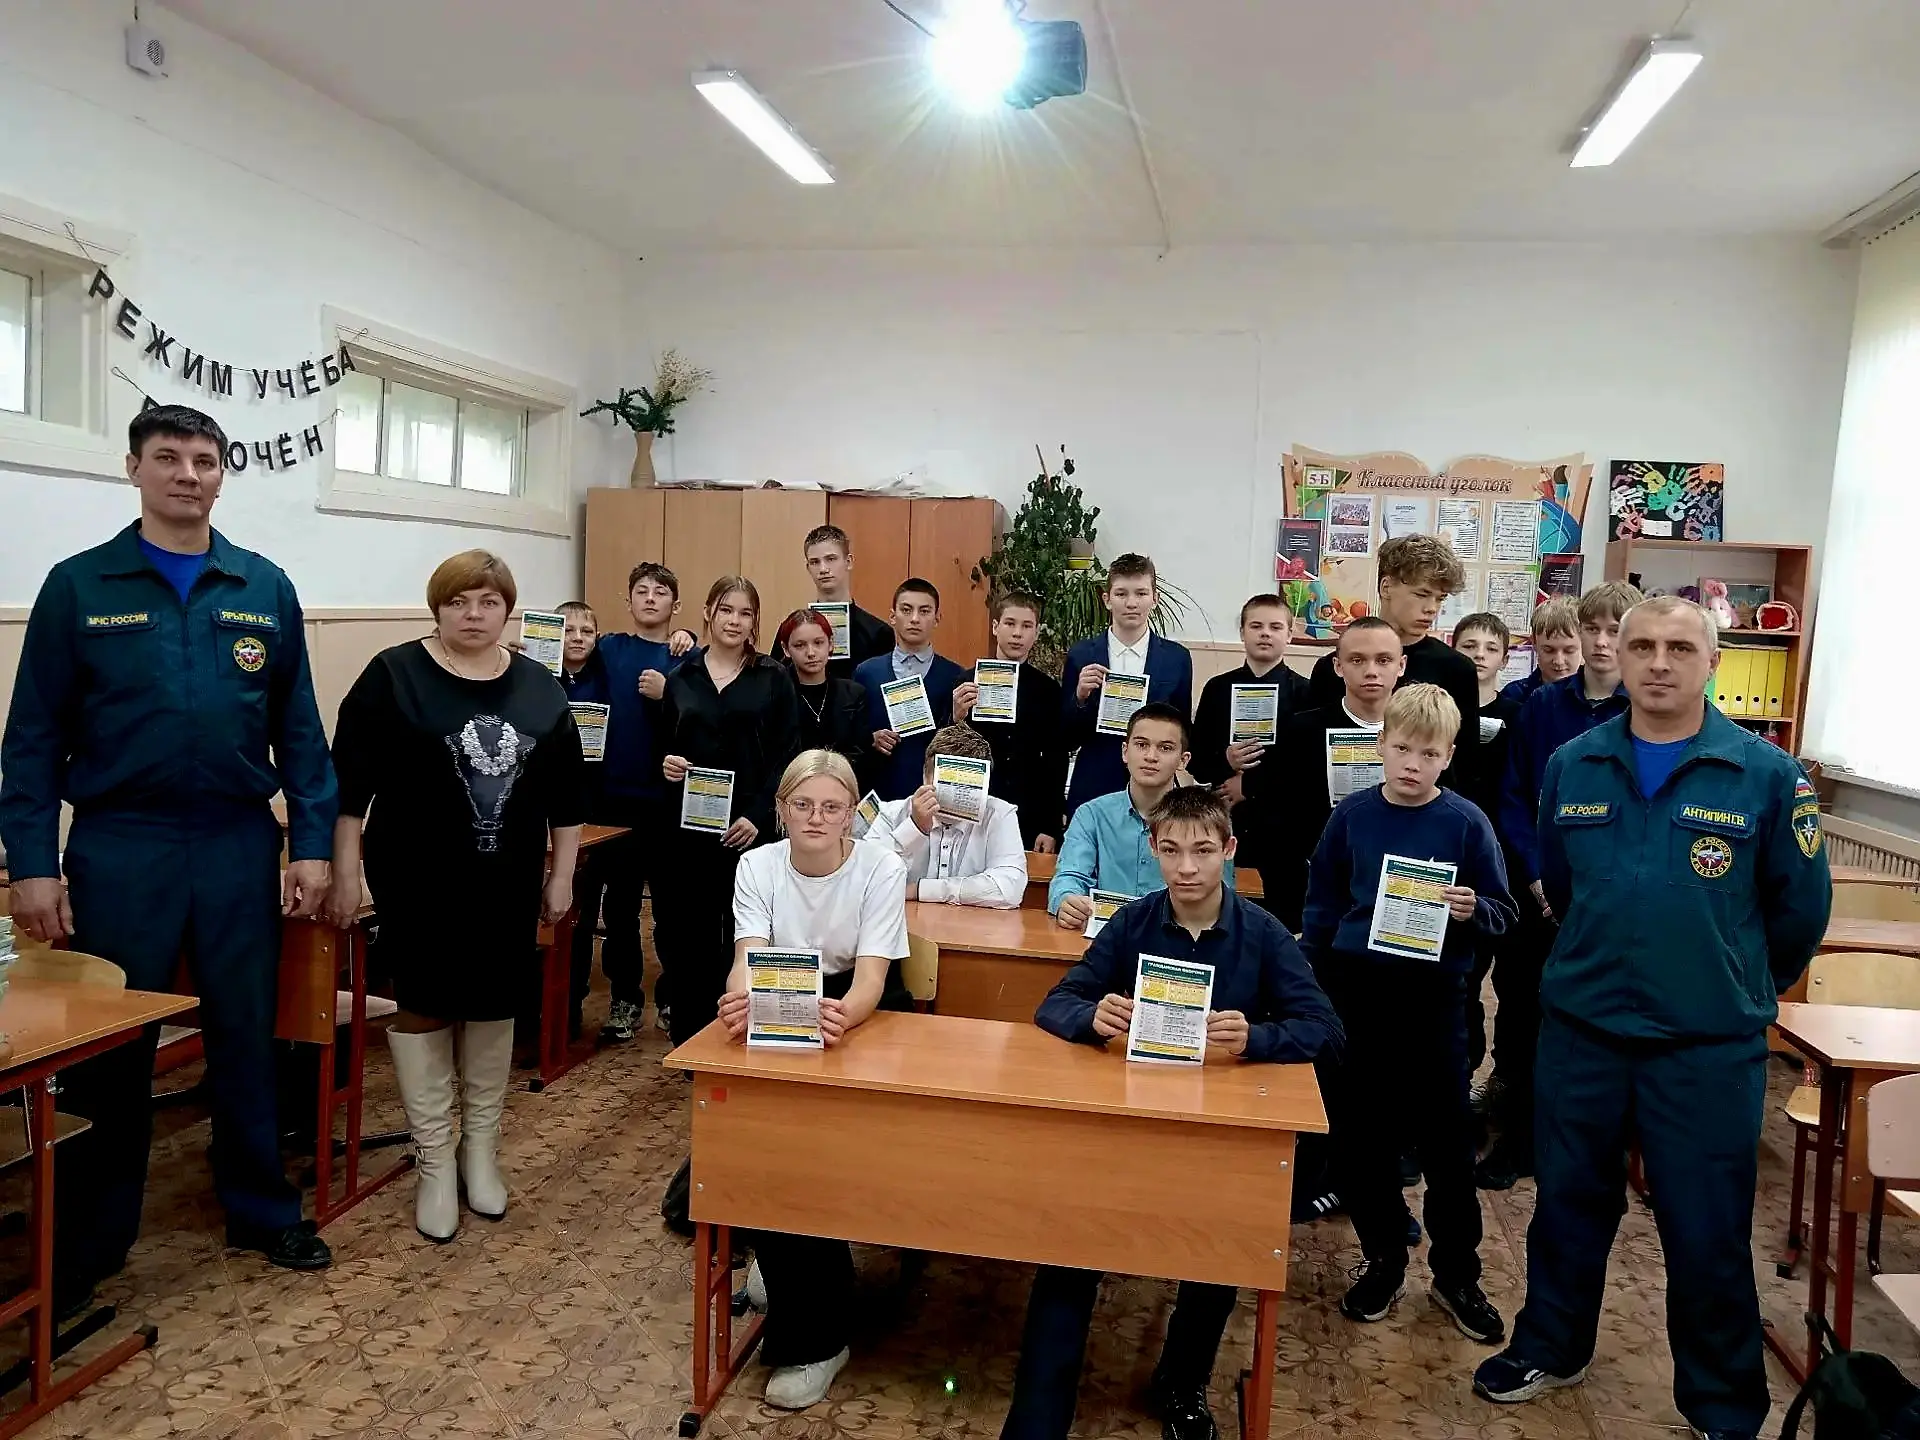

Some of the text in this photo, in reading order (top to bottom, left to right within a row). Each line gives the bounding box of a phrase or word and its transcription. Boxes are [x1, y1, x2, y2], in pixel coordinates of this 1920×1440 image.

[88, 268, 356, 400] РЕЖИМ УЧЁБА
[1308, 473, 1330, 486] 5-Б
[1356, 468, 1513, 495] Классный уголок
[89, 613, 148, 625] МЧС РОССИИ
[221, 611, 257, 623] ЯРЫГИН
[1577, 805, 1609, 815] РОССИИ
[1682, 806, 1731, 824] АНТИПИН
